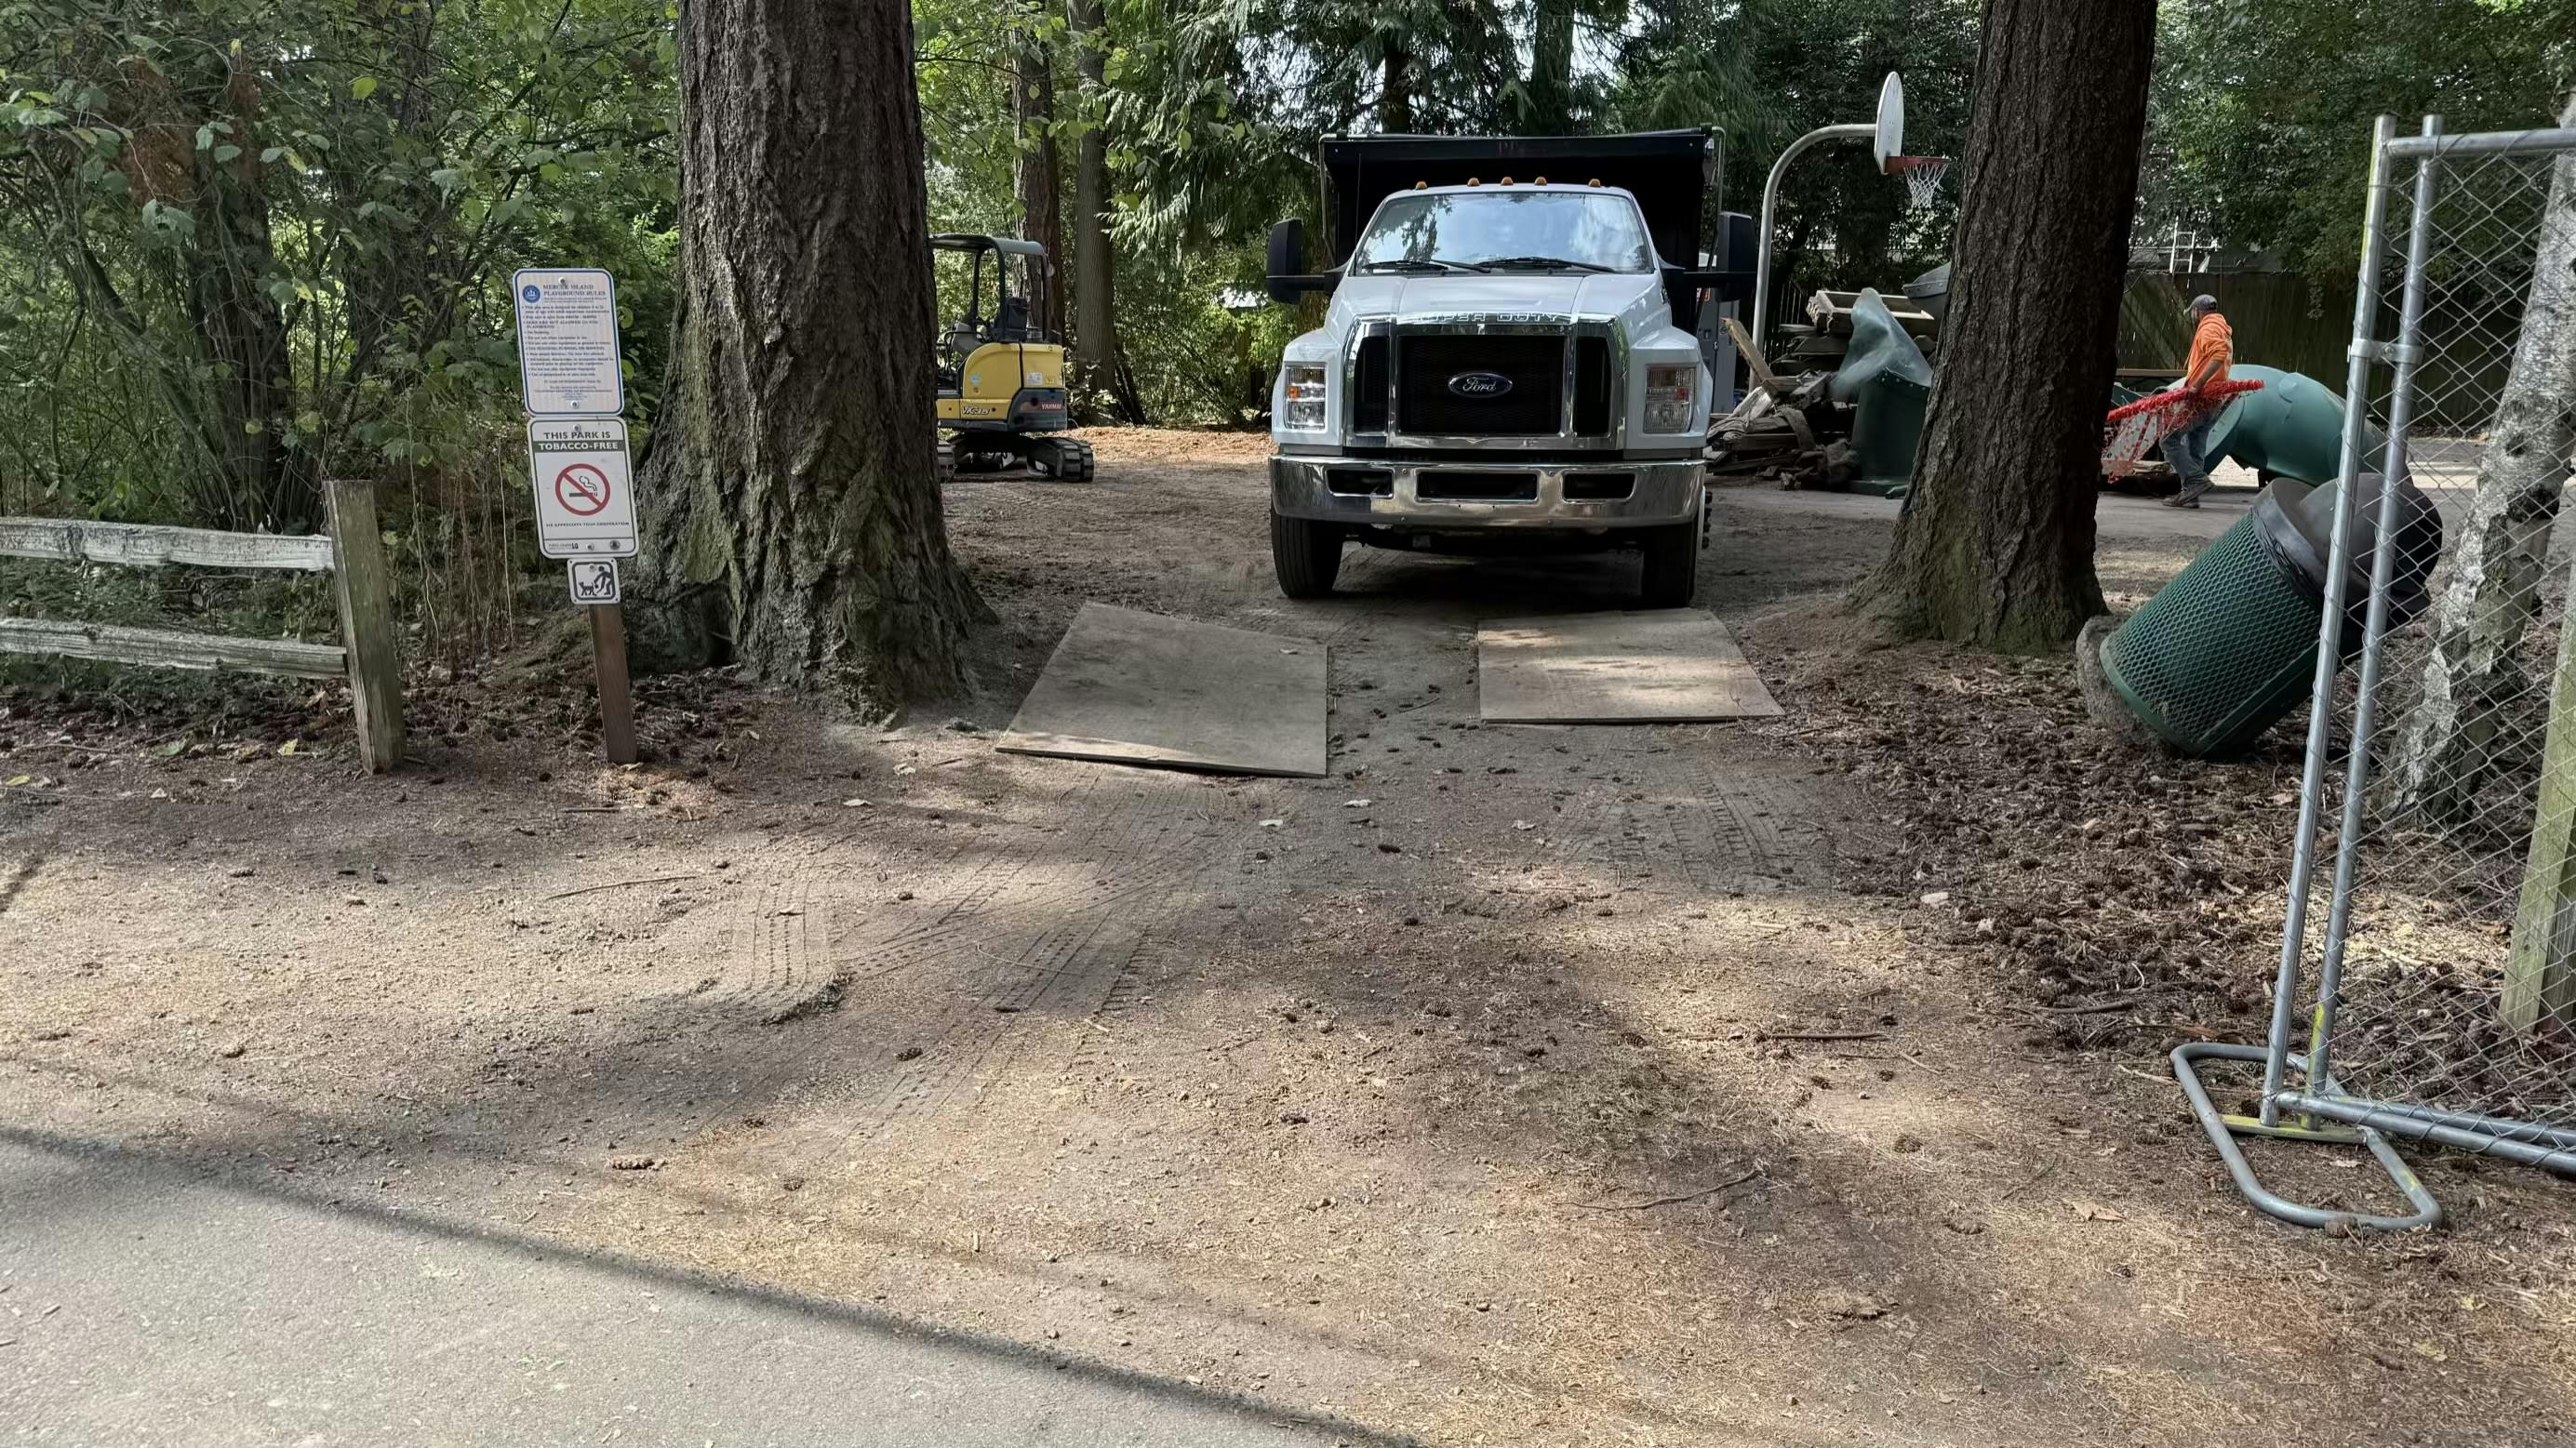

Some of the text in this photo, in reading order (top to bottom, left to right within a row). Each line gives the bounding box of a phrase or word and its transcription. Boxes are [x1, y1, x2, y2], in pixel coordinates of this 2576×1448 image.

[1496, 312, 1557, 323] DUTY
[1462, 377, 1497, 392] Ford
[543, 431, 611, 440] THIS PARK IS
[539, 442, 619, 450] TOBACCO-FREE
